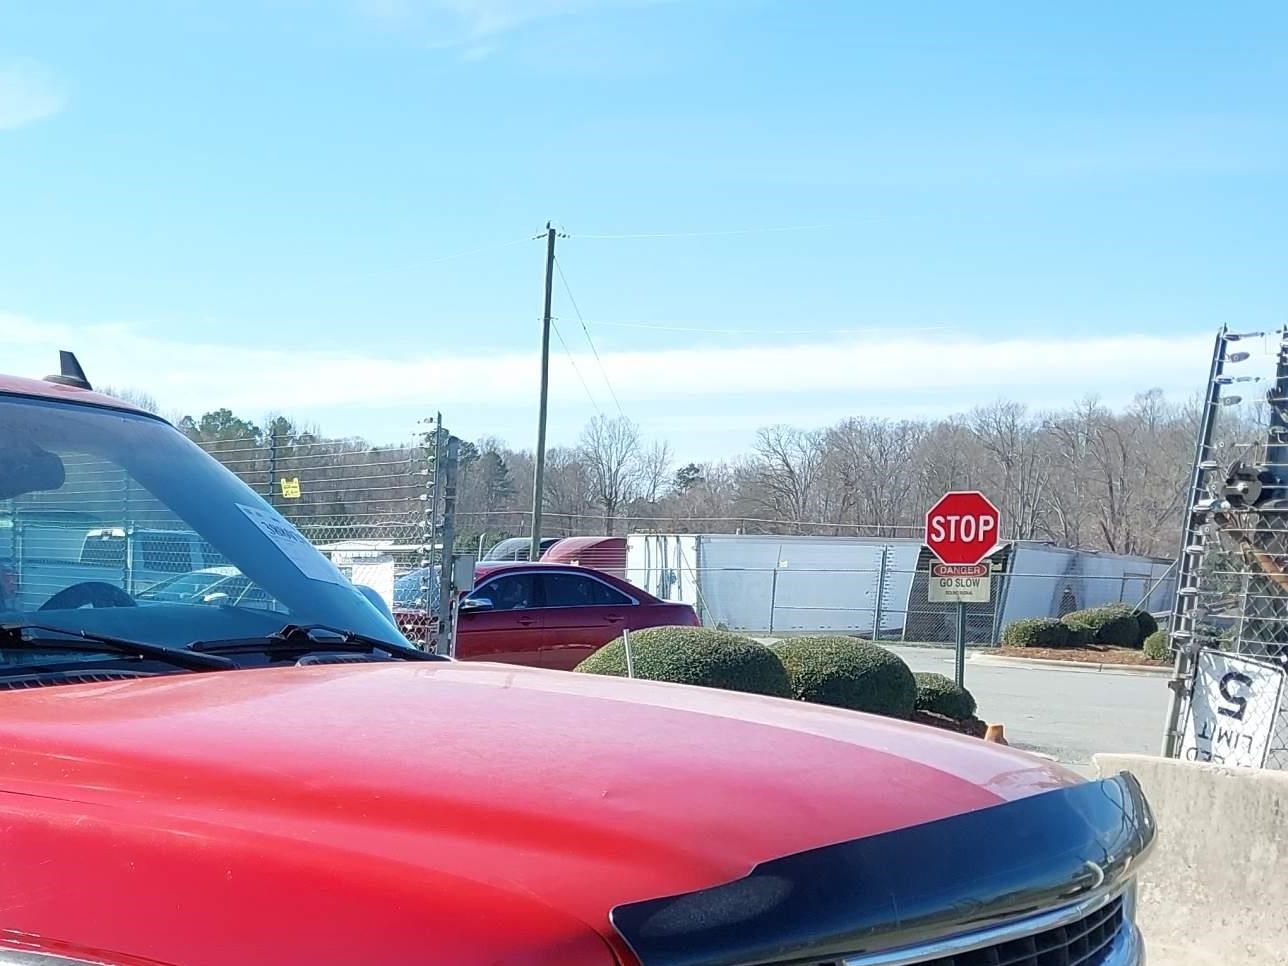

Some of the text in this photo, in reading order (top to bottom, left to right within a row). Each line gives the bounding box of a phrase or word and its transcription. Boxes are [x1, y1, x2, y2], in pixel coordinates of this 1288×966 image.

[930, 515, 995, 543] STOP
[939, 578, 981, 588] GO SLOW
[940, 566, 981, 575] DANGER
[1217, 671, 1253, 721] 5
[1197, 720, 1253, 754] LIMIT
